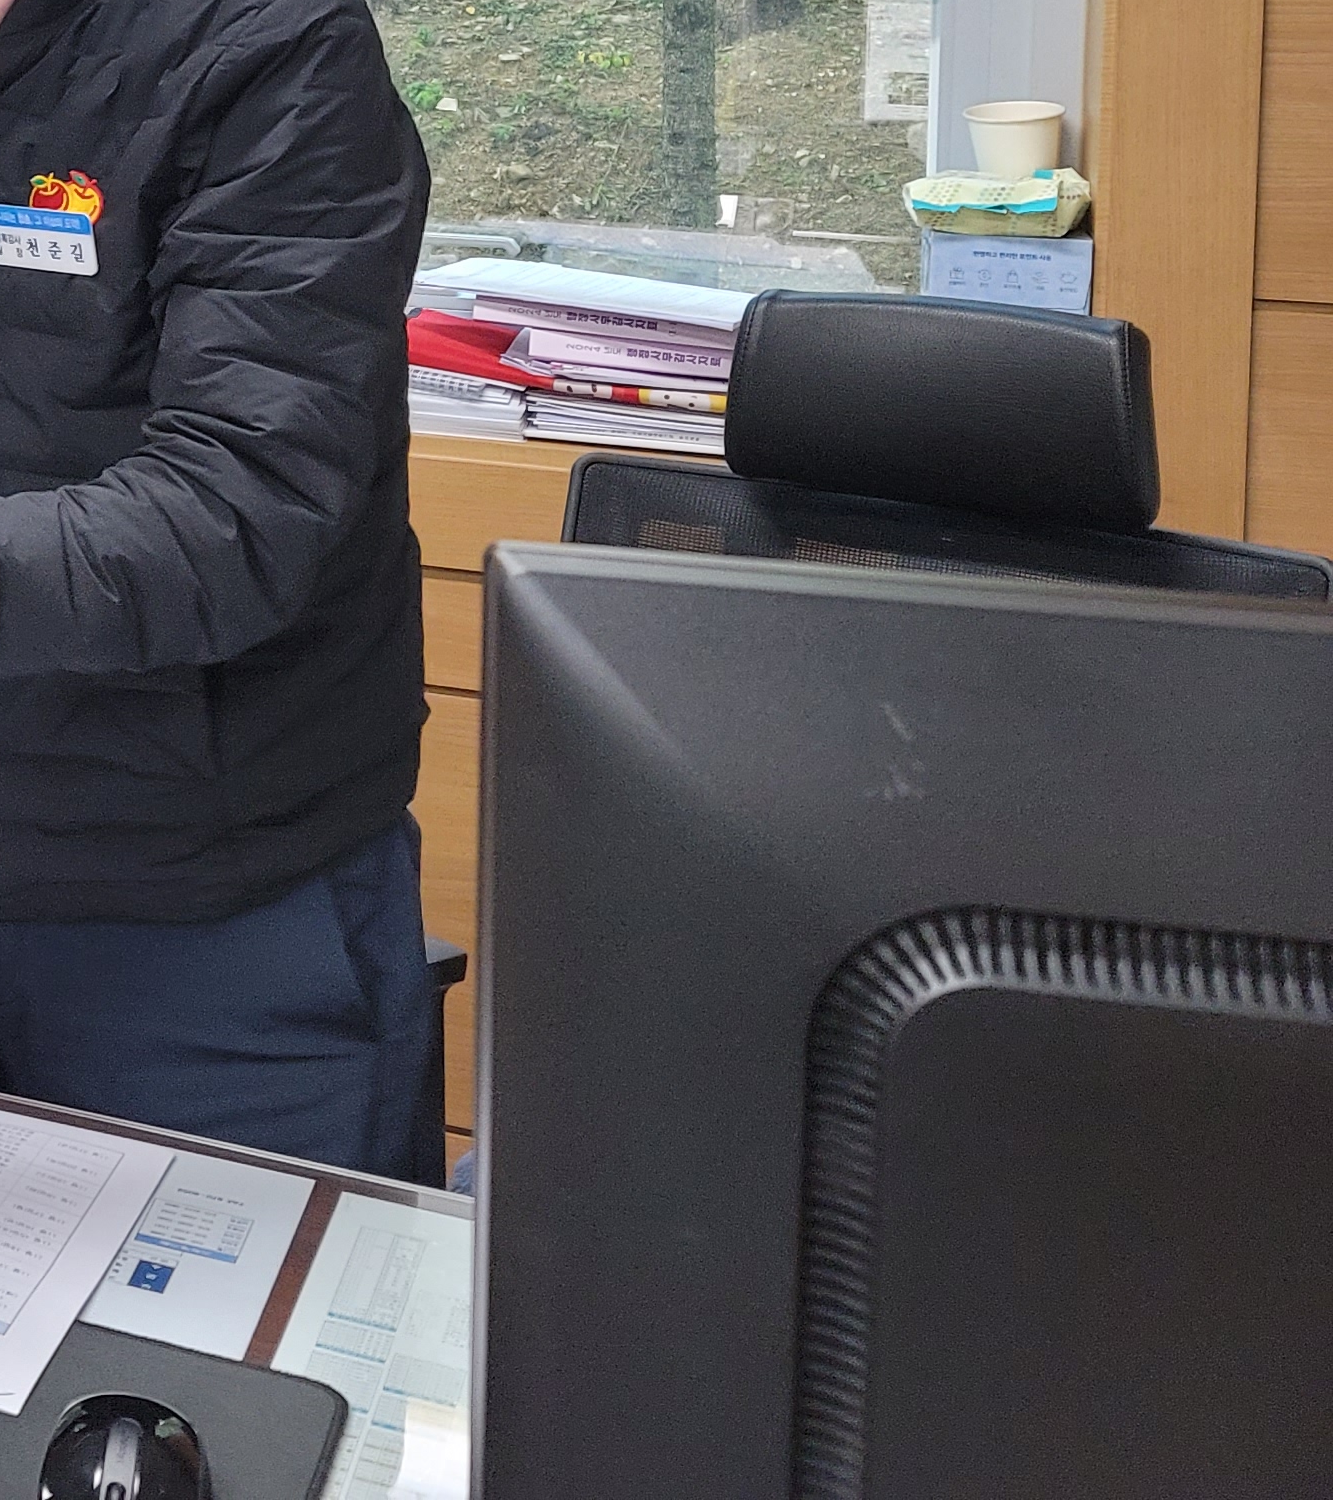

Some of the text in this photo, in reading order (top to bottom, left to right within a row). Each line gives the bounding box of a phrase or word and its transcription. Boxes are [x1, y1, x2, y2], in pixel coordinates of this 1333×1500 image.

[508, 305, 563, 320] 2024년도
[565, 311, 658, 332] 행정사무감사자료
[565, 342, 722, 368] 2024년도 행정사무감사자료
